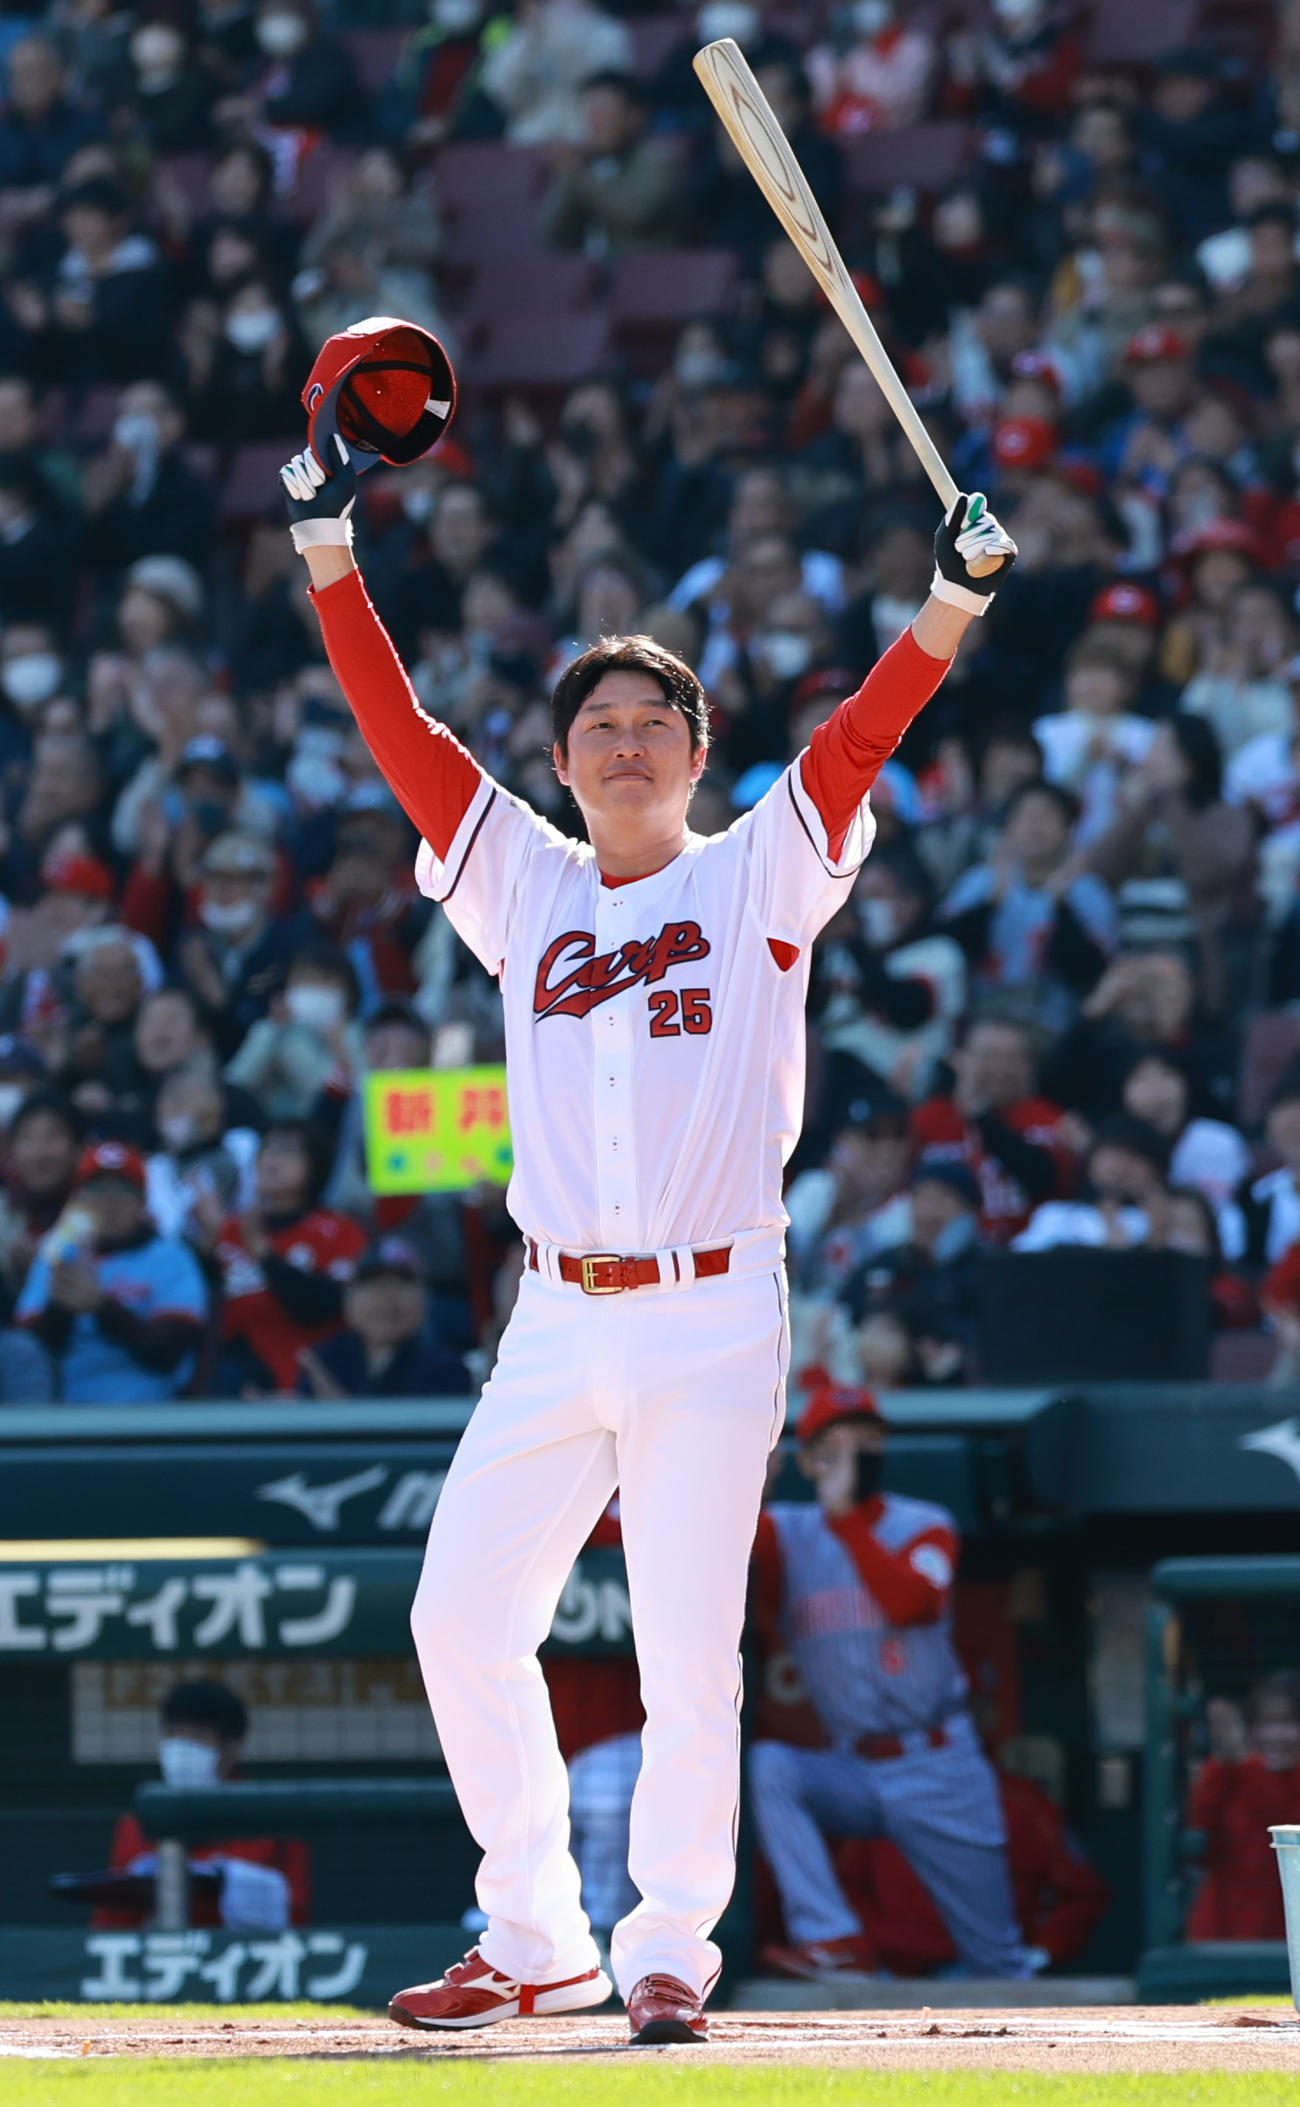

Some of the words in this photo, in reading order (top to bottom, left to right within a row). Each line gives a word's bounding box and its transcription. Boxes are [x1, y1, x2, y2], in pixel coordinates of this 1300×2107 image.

[533, 920, 711, 1024] Carp
[648, 988, 712, 1038] 25
[0, 1561, 356, 1651] エディオン
[82, 1932, 368, 2001] エディオン
